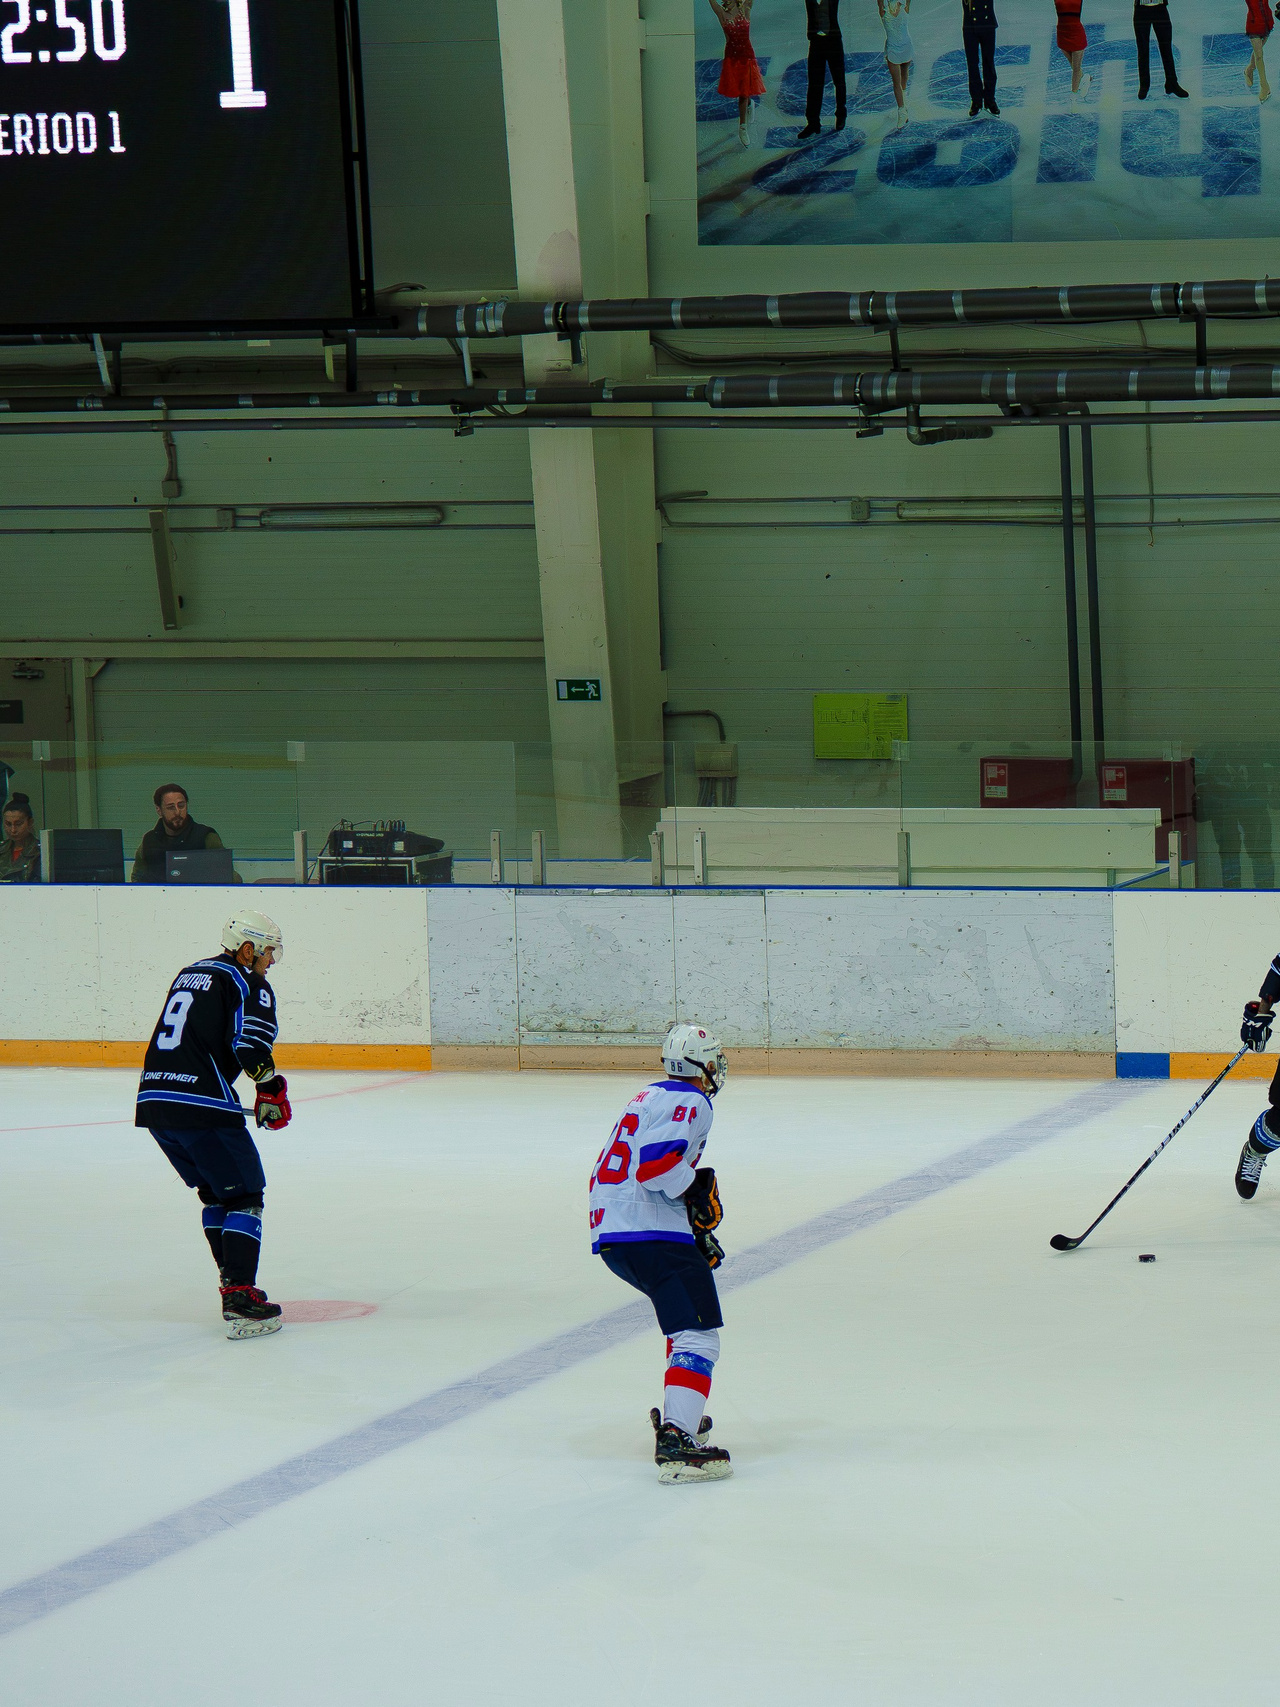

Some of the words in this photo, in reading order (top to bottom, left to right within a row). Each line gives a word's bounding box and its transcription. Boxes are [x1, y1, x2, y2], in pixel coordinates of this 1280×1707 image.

[108, 110, 126, 153] 1
[751, 105, 1262, 198] 2014
[259, 988, 272, 1008] 9
[156, 990, 194, 1051] 9
[144, 1071, 163, 1080] ONE
[162, 1071, 199, 1084] TIMER
[670, 1061, 683, 1073] 86
[589, 1112, 639, 1193] 6
